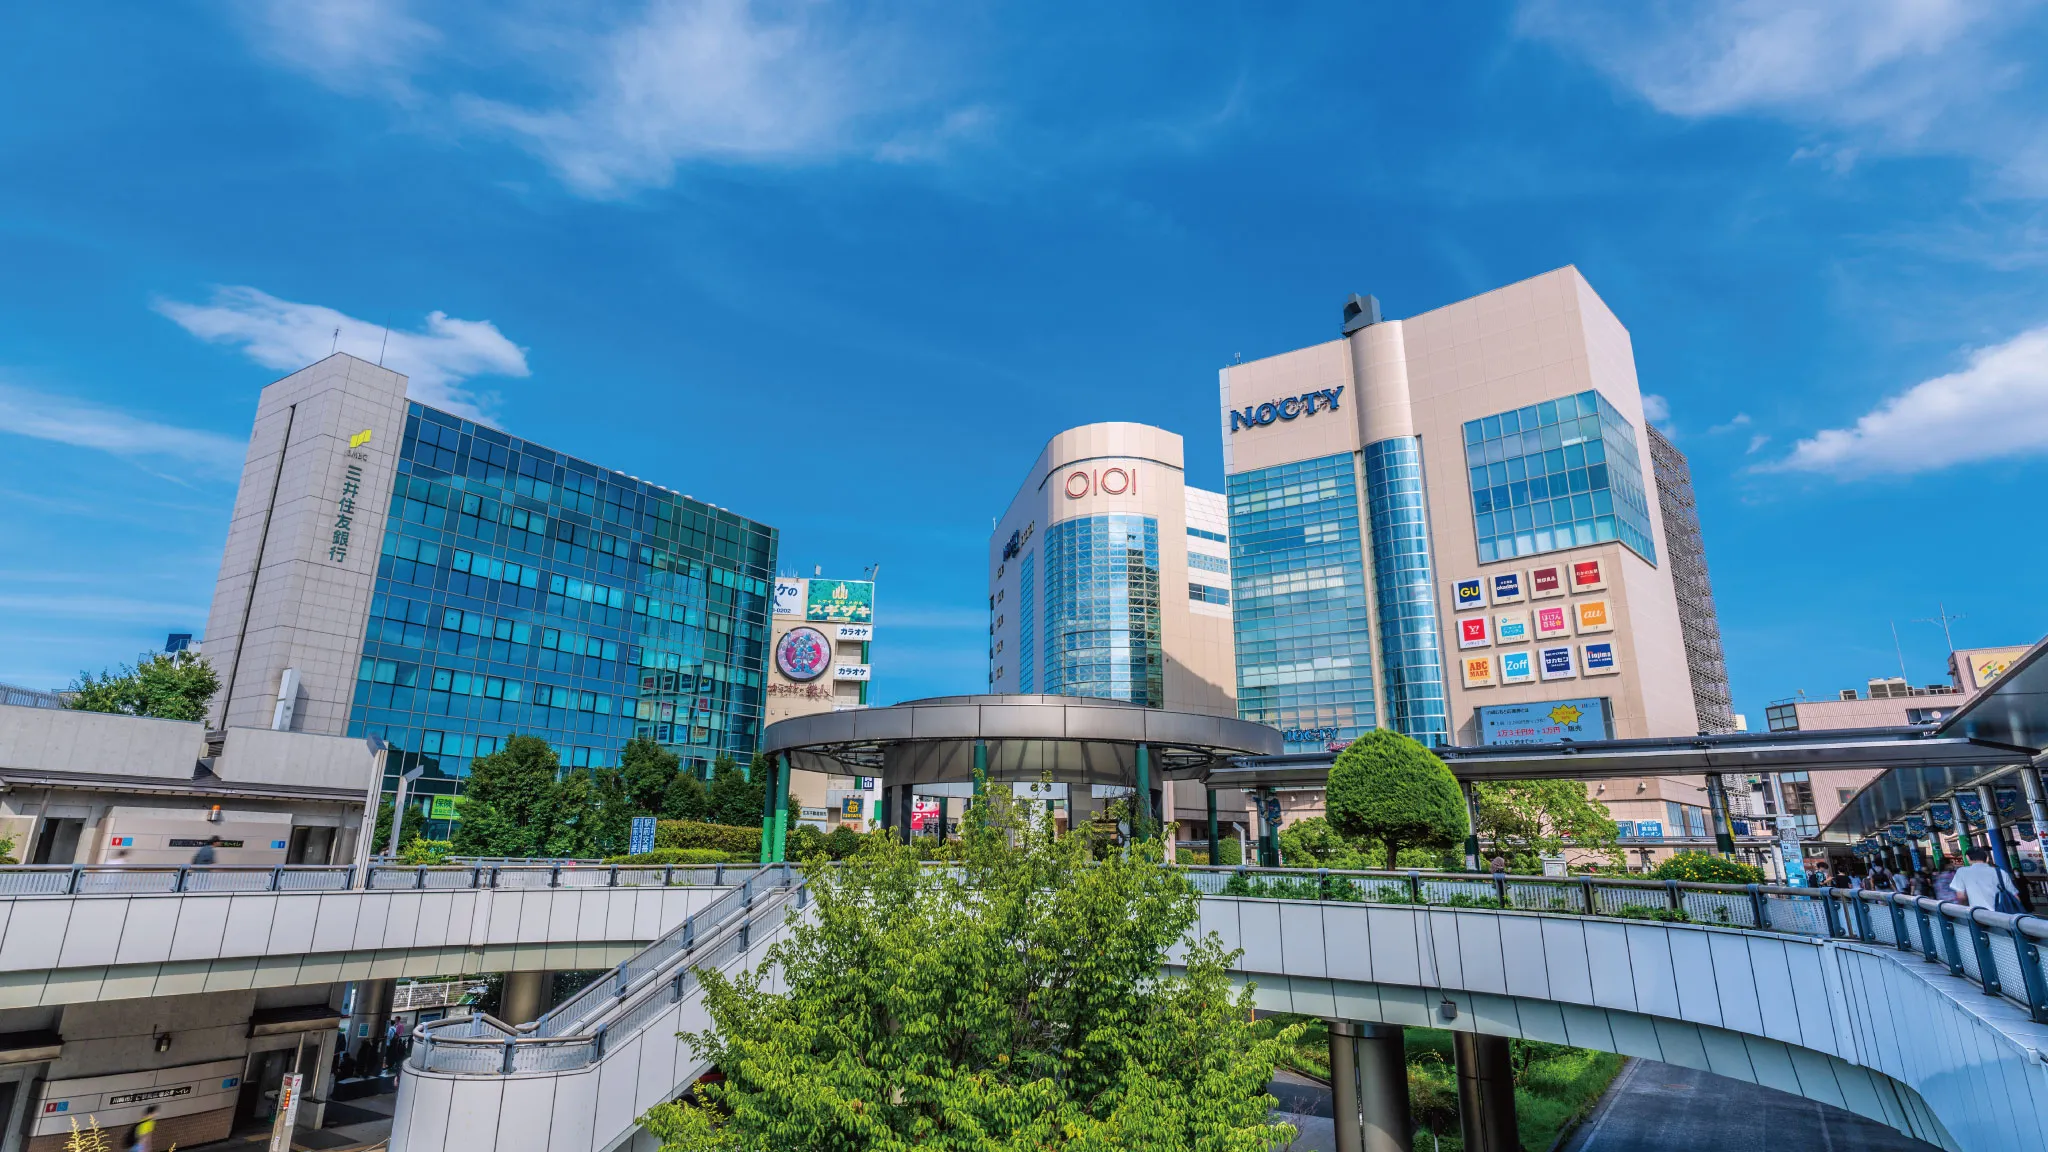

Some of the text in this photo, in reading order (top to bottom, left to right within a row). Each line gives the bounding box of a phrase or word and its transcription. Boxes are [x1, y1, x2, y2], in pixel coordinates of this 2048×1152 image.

[1230, 385, 1345, 431] NOCTY
[329, 465, 362, 563] 三井住友銀行
[776, 584, 798, 597] ケの
[1460, 586, 1479, 597] GU
[809, 604, 871, 617] スギザキ
[1583, 610, 1603, 618] au
[840, 628, 869, 636] カラオケ
[1469, 661, 1488, 671] ABC
[1506, 660, 1527, 670] Zoff
[838, 667, 866, 675] カラオケ
[294, 1078, 300, 1087] 7
